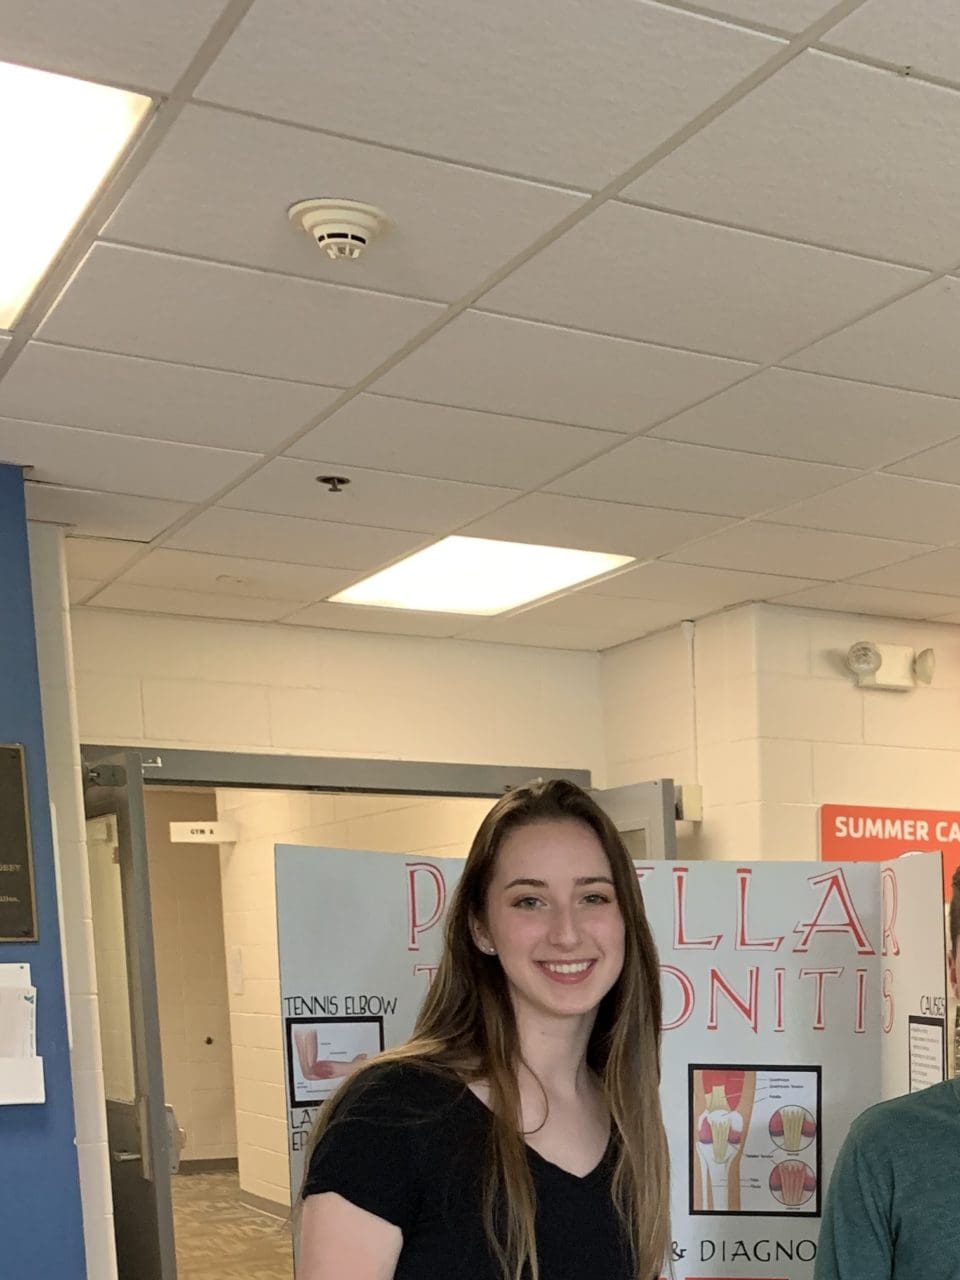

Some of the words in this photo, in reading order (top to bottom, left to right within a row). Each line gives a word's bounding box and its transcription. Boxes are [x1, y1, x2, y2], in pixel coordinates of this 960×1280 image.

[835, 816, 929, 841] SUMMER
[284, 995, 338, 1016] TENNIS
[345, 995, 398, 1016] ELBOW
[700, 1239, 818, 1263] DIAGNO
